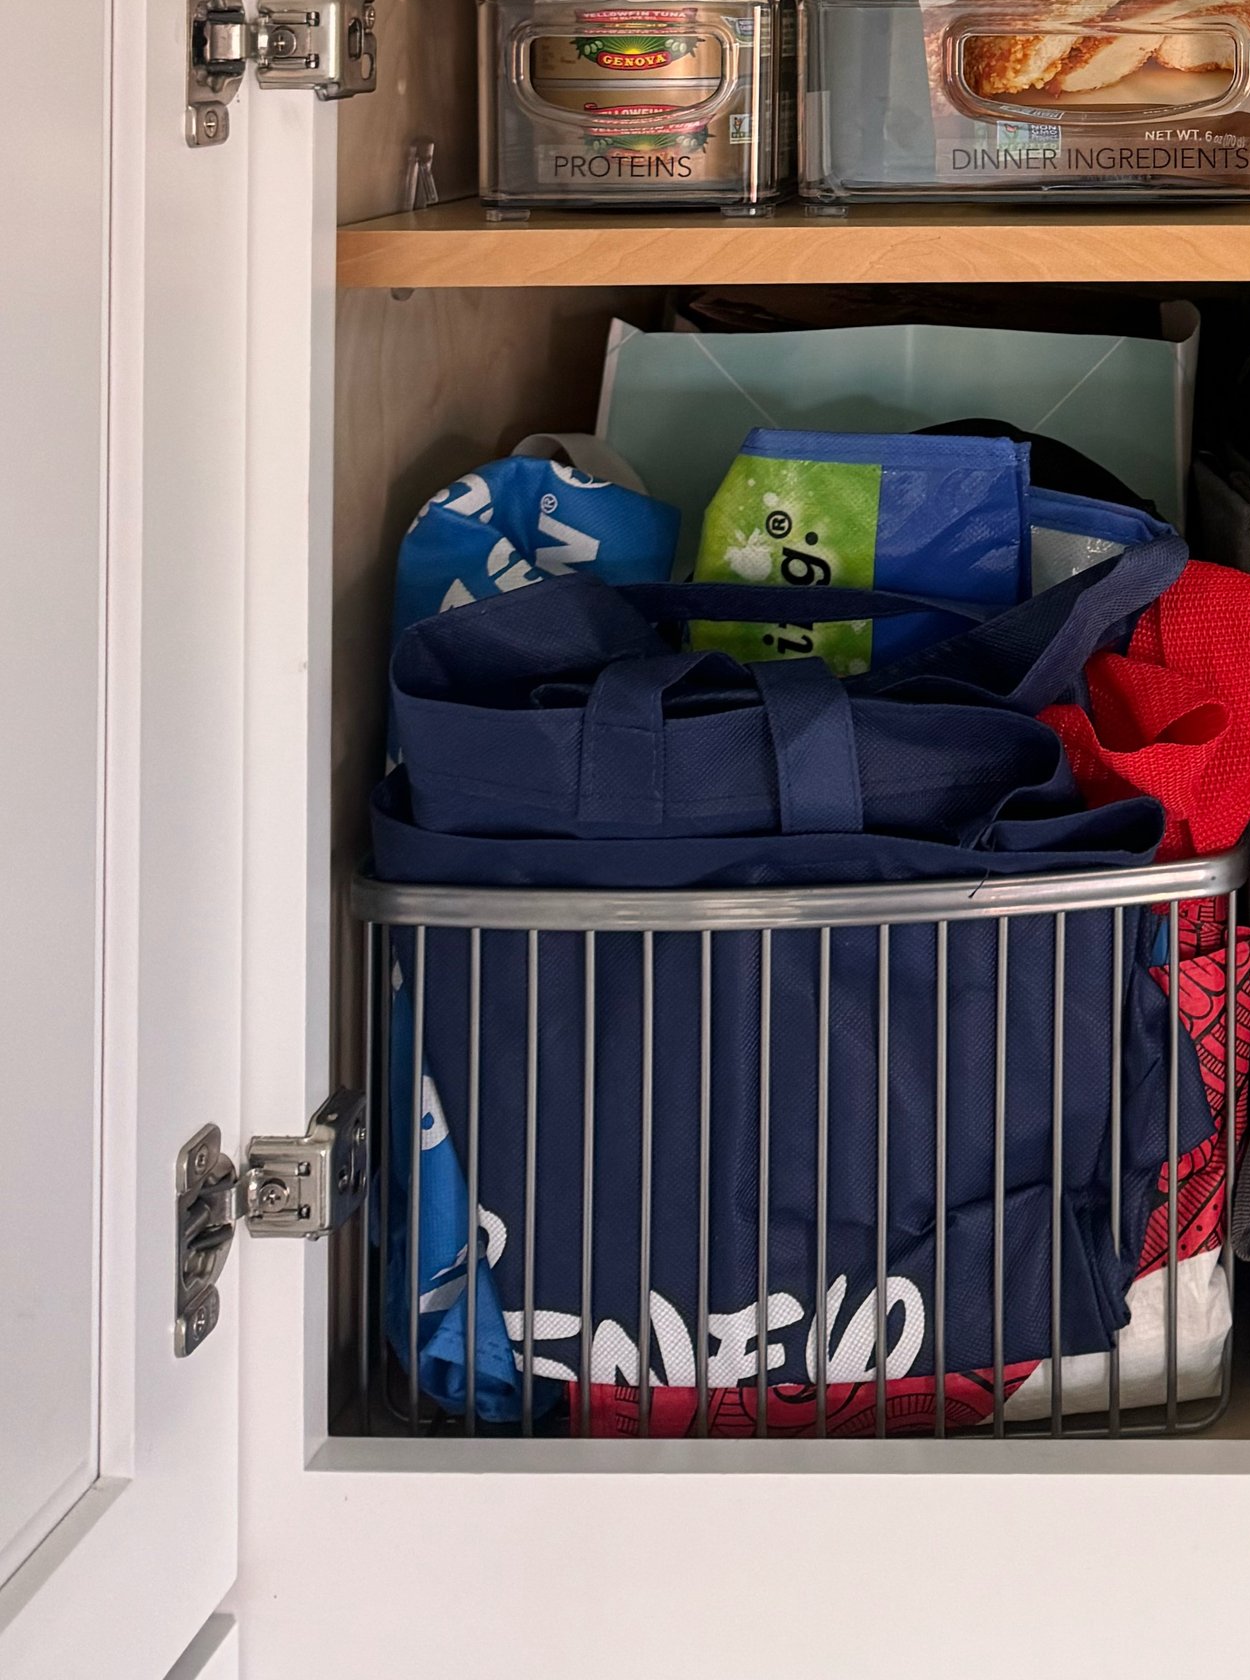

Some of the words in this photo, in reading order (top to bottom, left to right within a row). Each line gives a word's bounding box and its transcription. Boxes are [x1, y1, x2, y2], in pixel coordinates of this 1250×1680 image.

[653, 10, 687, 18] TUNA
[604, 54, 667, 67] GENOVA
[1145, 130, 1173, 141] NET
[1177, 130, 1202, 141] WT.
[1205, 131, 1213, 142] 6
[1213, 135, 1224, 144] oz
[952, 147, 1058, 170] DINNER
[1067, 146, 1250, 170] INGREDIENTS
[555, 155, 692, 178] PROTEINS
